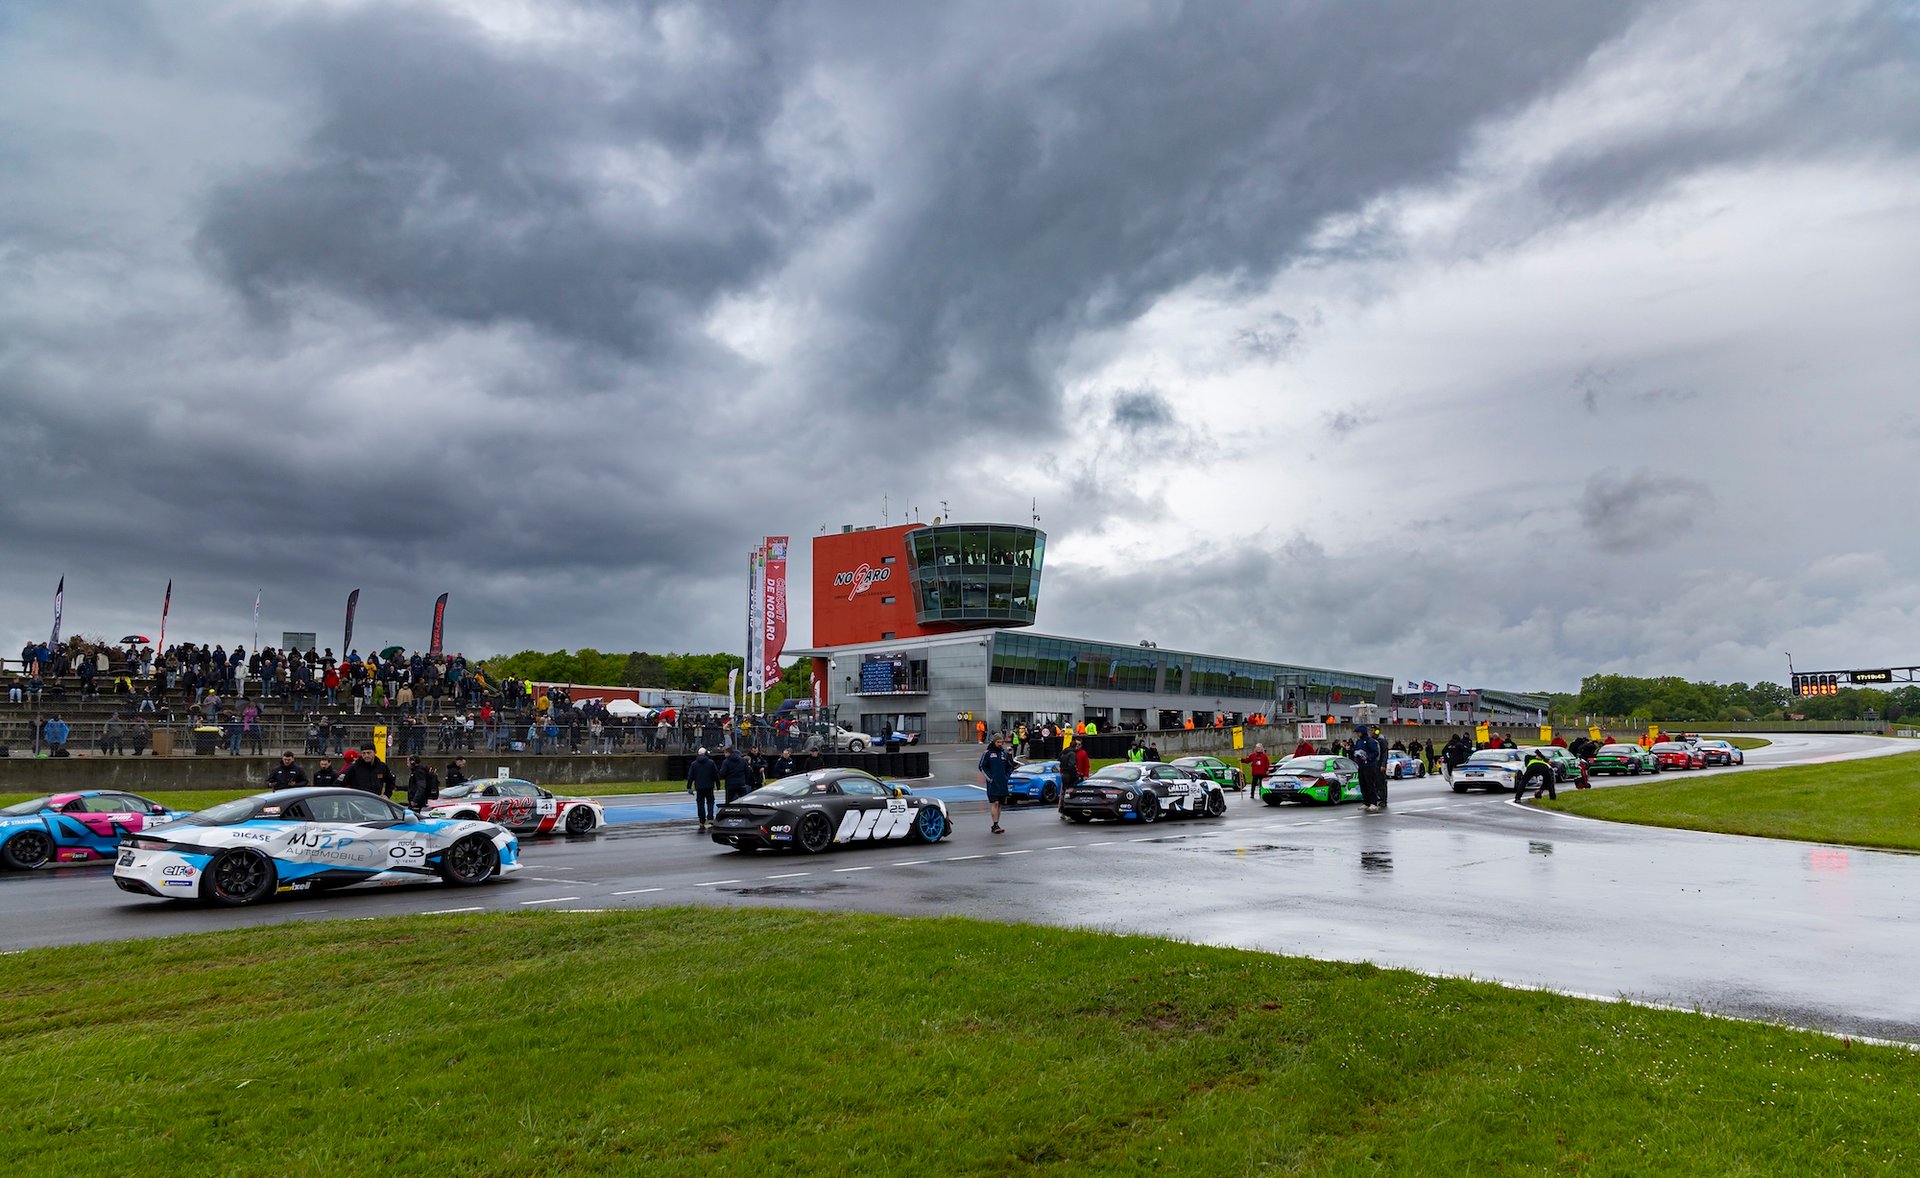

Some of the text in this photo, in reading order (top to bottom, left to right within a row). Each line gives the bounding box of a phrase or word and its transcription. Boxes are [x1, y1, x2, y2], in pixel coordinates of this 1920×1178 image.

[834, 563, 891, 601] NOGARO
[776, 577, 785, 623] CIRCUIT
[766, 578, 775, 641] DE NOGARO
[432, 603, 443, 647] WELCOME
[1301, 725, 1323, 738] SUD OUEST
[889, 804, 906, 813] 25
[232, 832, 271, 843] DICASE
[287, 832, 353, 850] MJ2P
[286, 847, 364, 861] AUTOMOBILE
[389, 846, 425, 858] 03
[163, 866, 184, 875] elf
[292, 881, 311, 891] ixell
